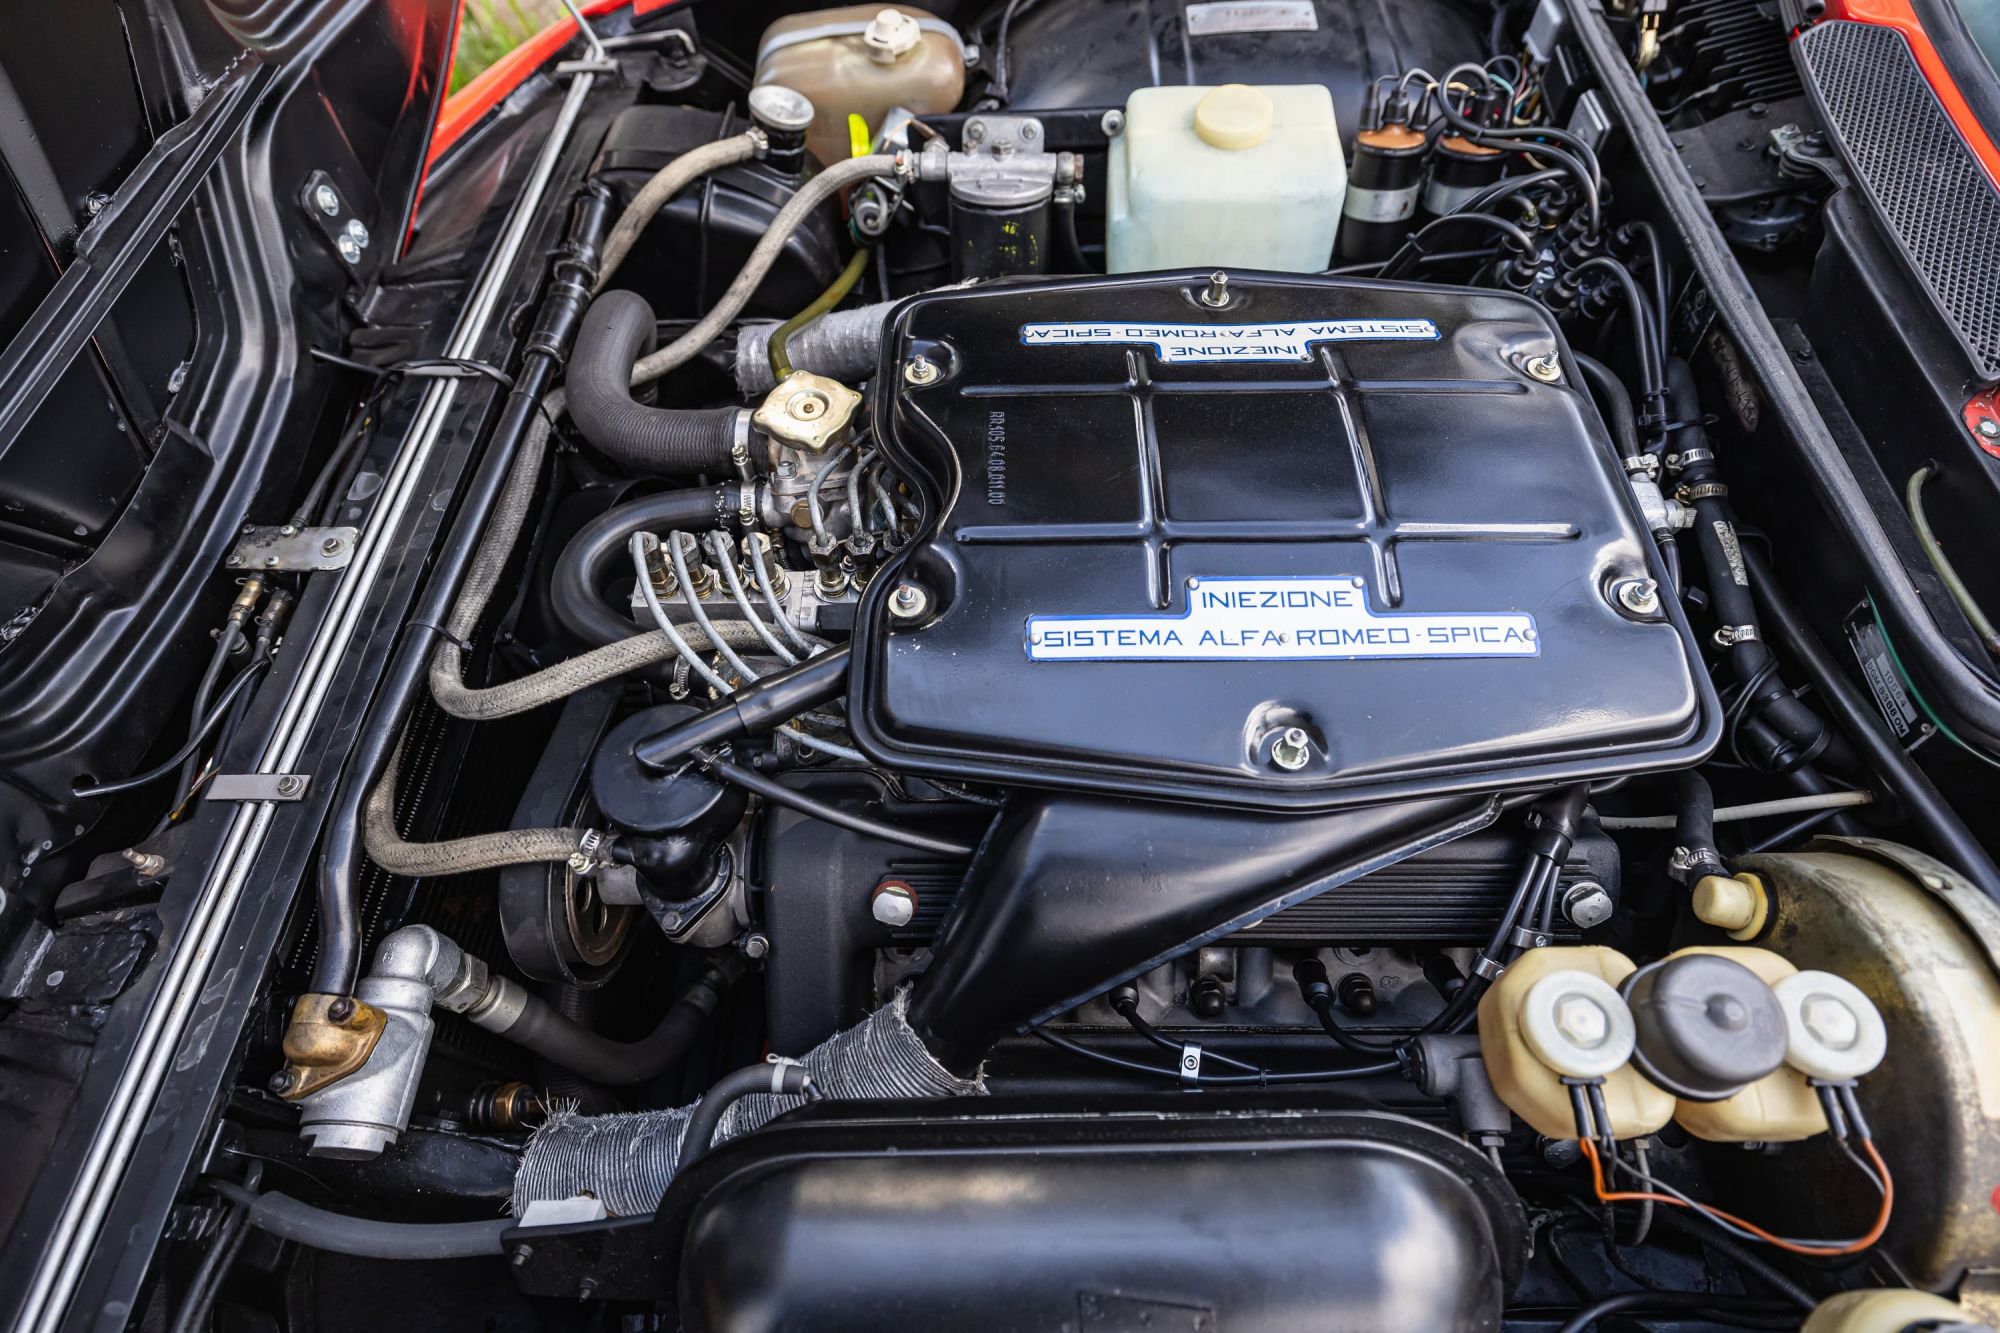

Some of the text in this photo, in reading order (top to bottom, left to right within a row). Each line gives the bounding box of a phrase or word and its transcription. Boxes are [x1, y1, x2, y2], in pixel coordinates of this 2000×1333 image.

[1228, 327, 1296, 338] ALFA
[1308, 324, 1424, 335] SISTEMA
[1169, 345, 1298, 356] INIEZIONE
[1202, 590, 1353, 608] INIEZIONE
[1043, 629, 1184, 648] SISTEMA
[1198, 629, 1281, 647] ALFA
[1867, 662, 1881, 686] DGM
[1894, 717, 1906, 735] OM
[1884, 671, 1907, 708] 10564
